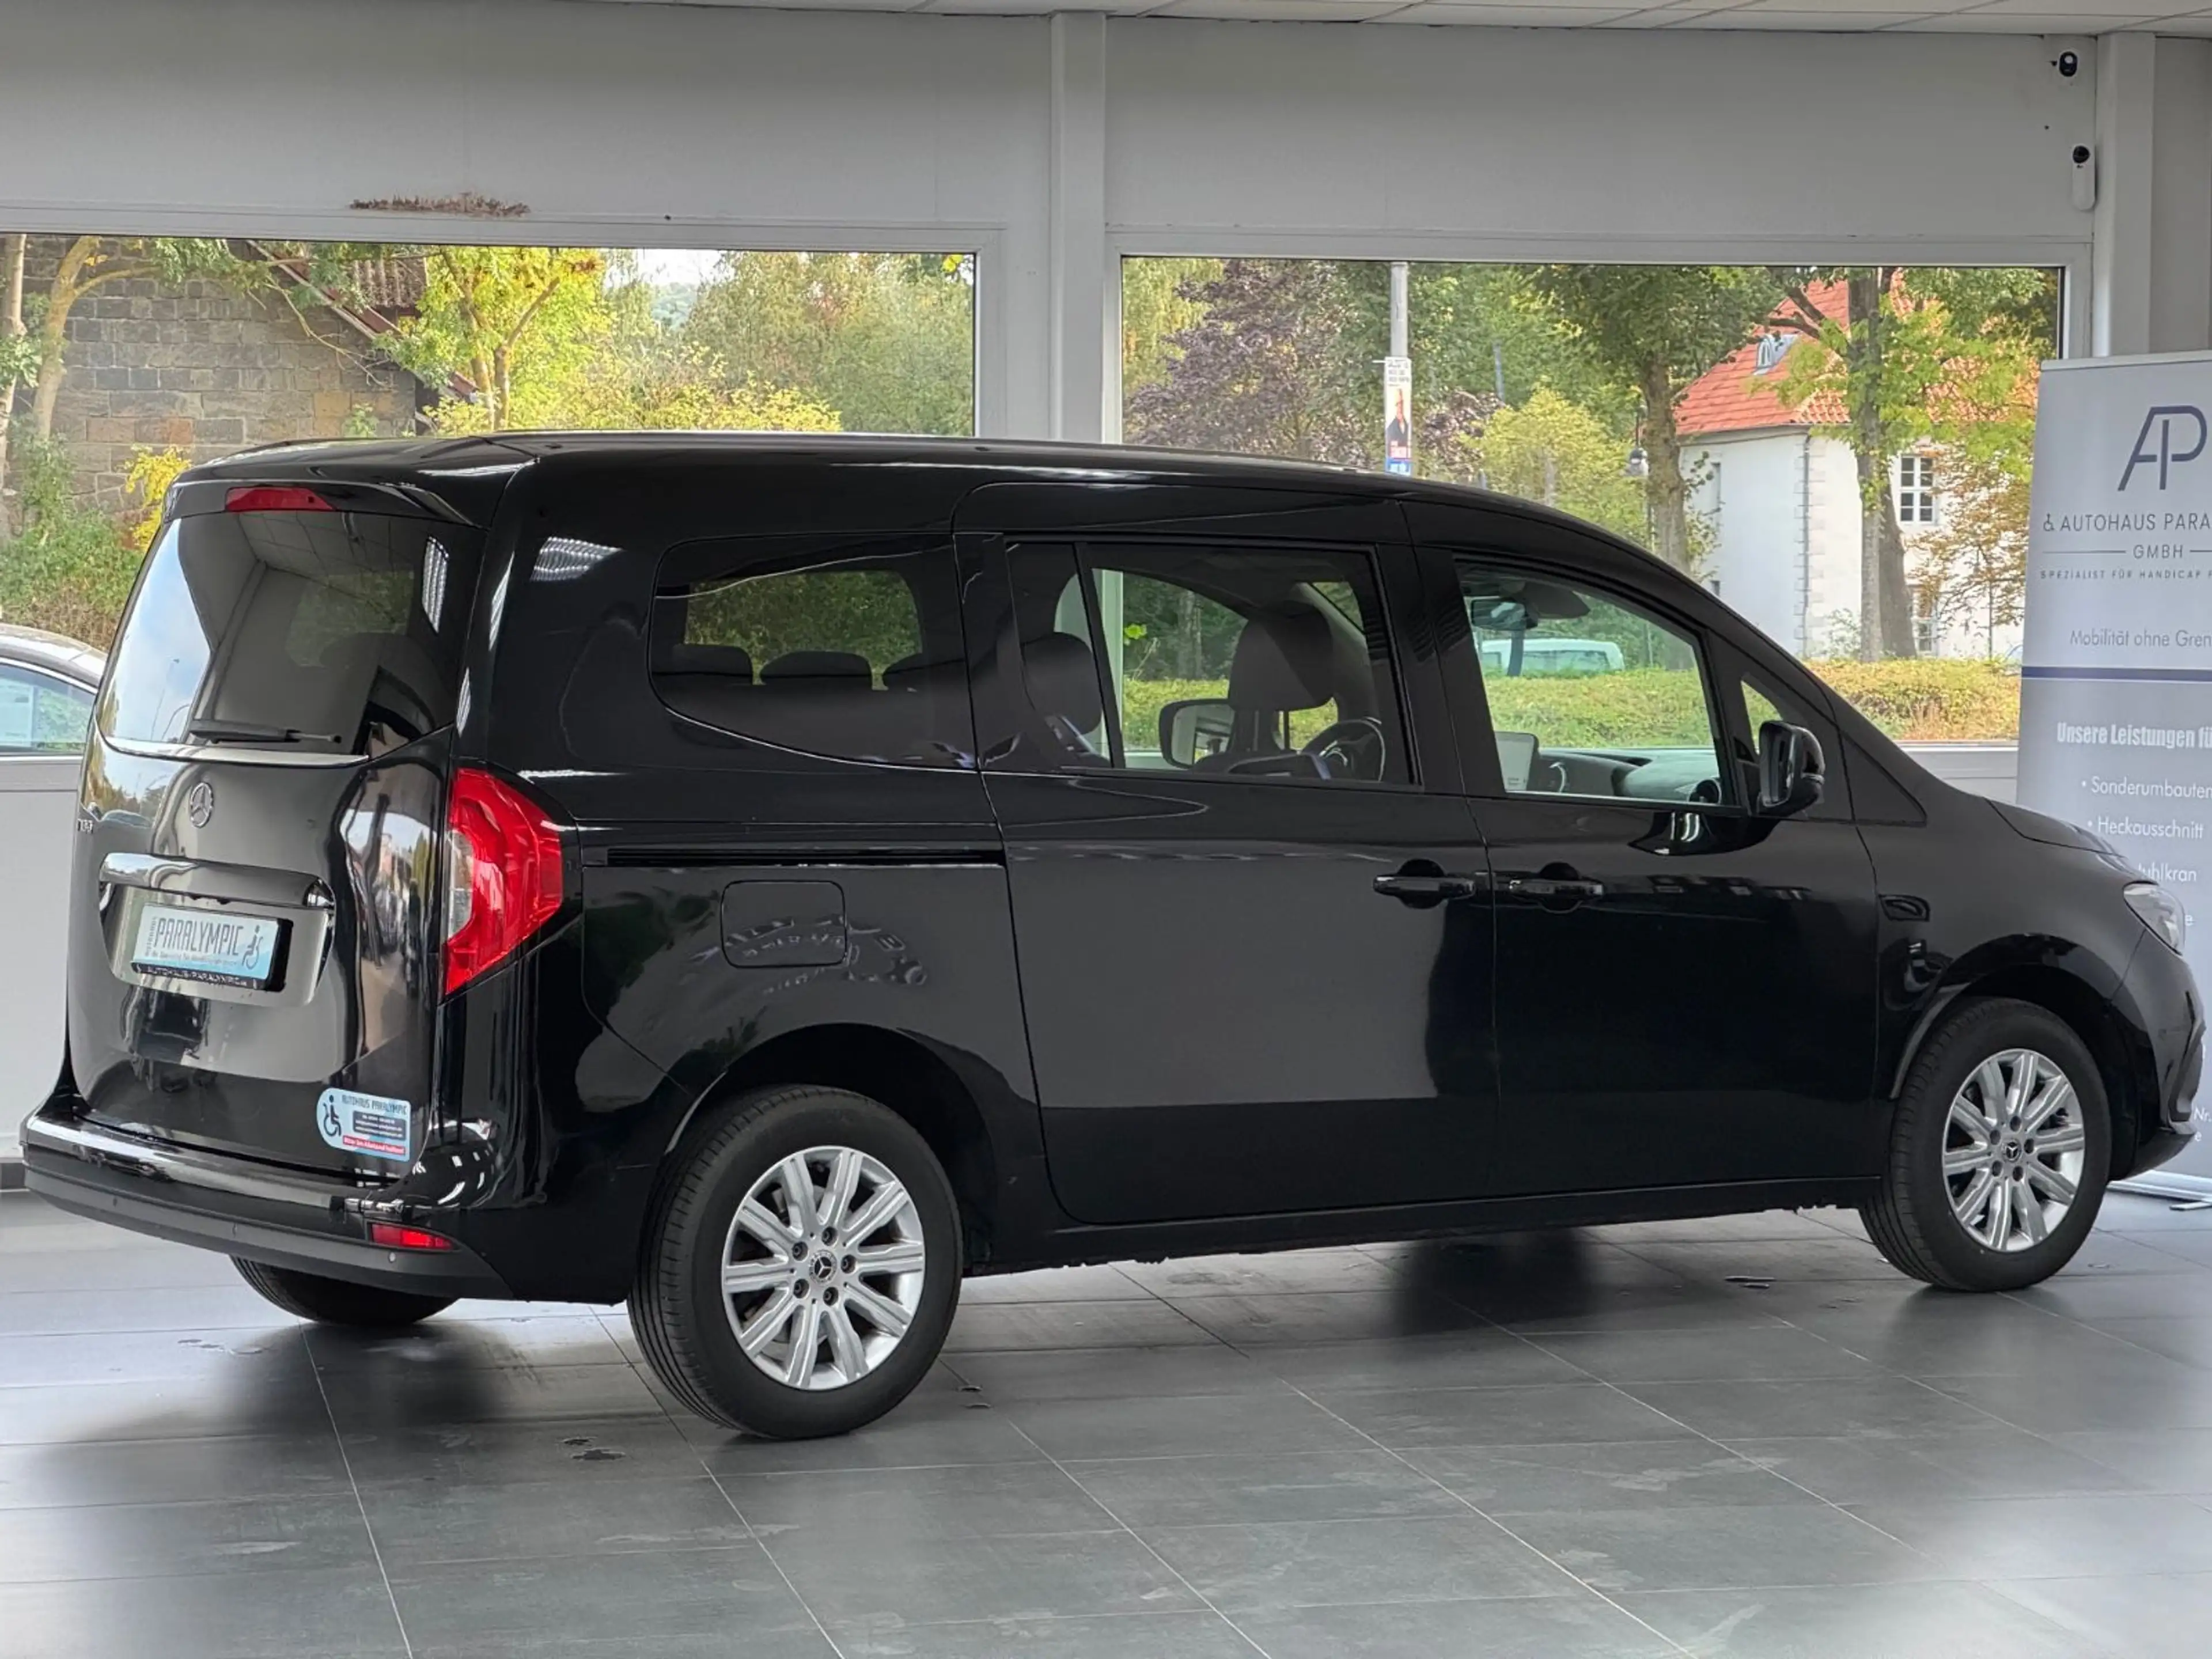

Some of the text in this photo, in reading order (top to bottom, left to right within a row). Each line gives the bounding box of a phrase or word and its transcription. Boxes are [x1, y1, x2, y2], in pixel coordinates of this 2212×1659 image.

[2060, 513, 2211, 532] AUTOHAUS PARA
[2133, 544, 2184, 559] GMBH
[2040, 569, 2105, 579] SPEZIALIST
[2112, 568, 2132, 579] FÜR
[2140, 569, 2201, 579] HANDICAP
[2070, 628, 2130, 646] Mobilität
[2134, 628, 2170, 647] ohne
[2057, 722, 2108, 744] Unsere
[2111, 724, 2195, 749] Leistungen
[2091, 776, 2212, 799] Sonderumbauten
[2097, 816, 2204, 839] Heckausschnitt
[154, 918, 244, 956] PARALYMPIC
